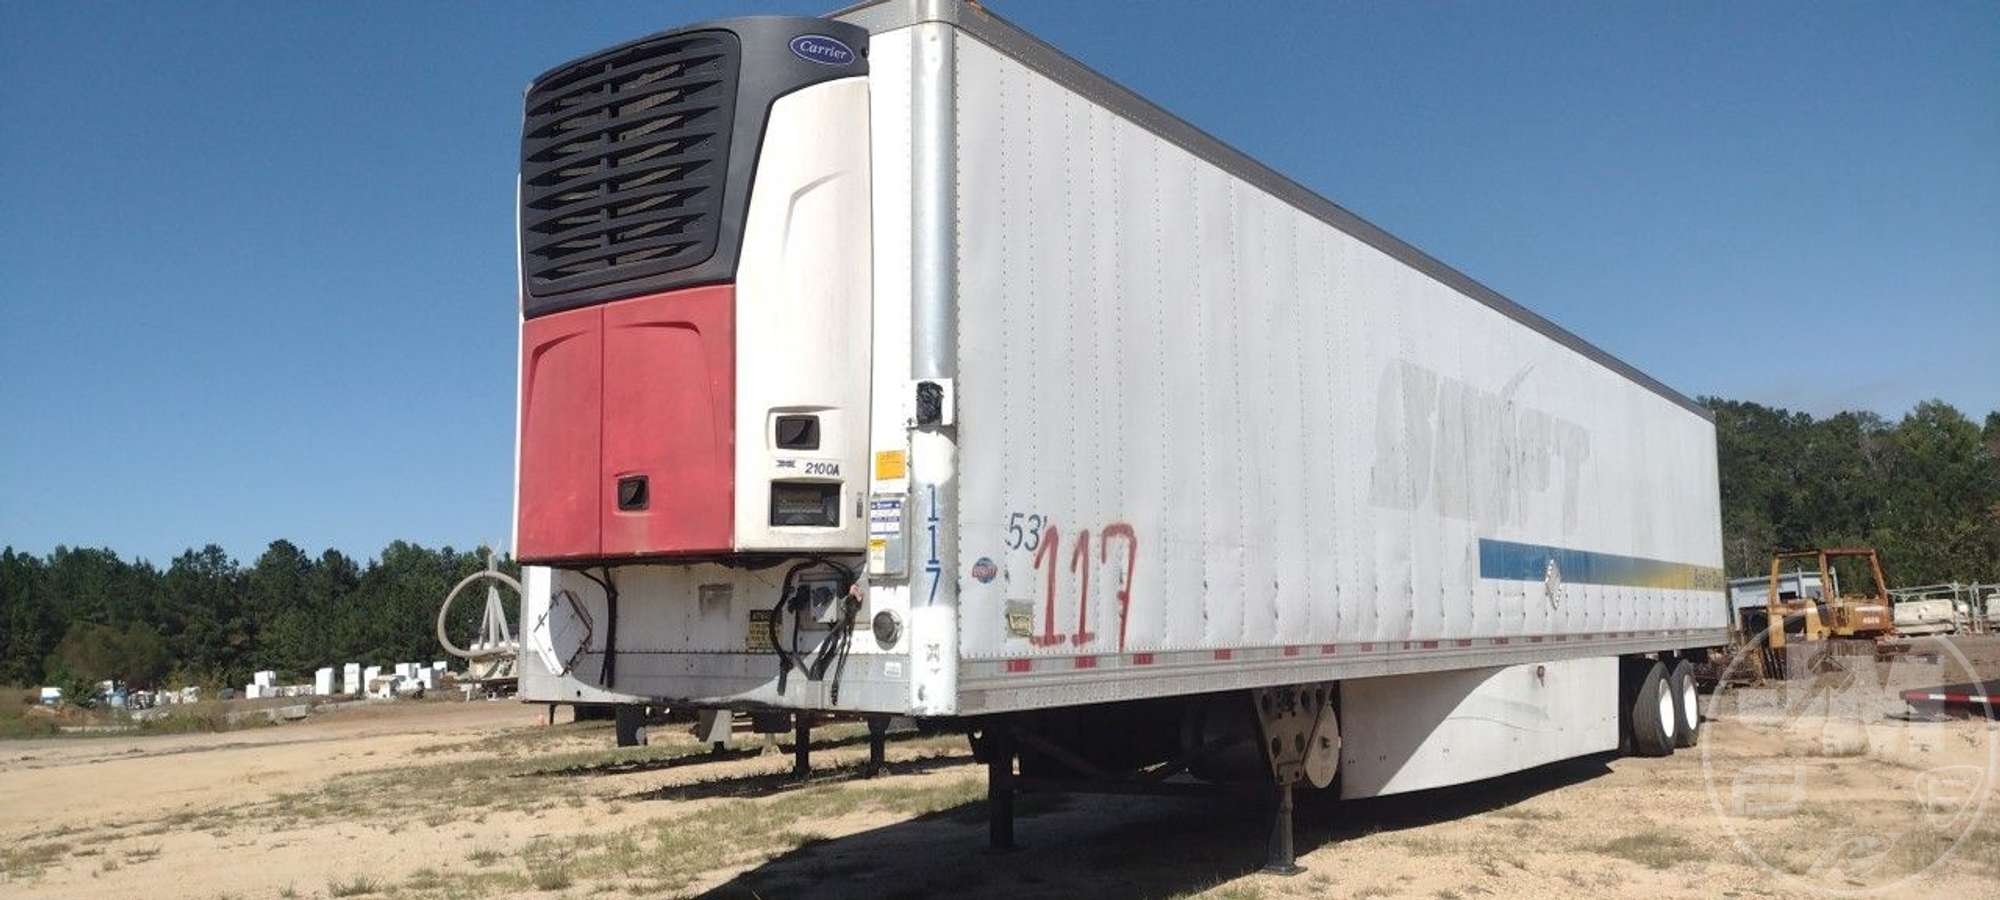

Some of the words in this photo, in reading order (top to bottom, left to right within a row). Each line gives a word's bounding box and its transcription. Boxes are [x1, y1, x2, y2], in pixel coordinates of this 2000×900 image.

[799, 40, 847, 60] Carrier
[804, 461, 841, 477] 2100A
[925, 484, 941, 608] 117
[1028, 522, 1138, 654] 117
